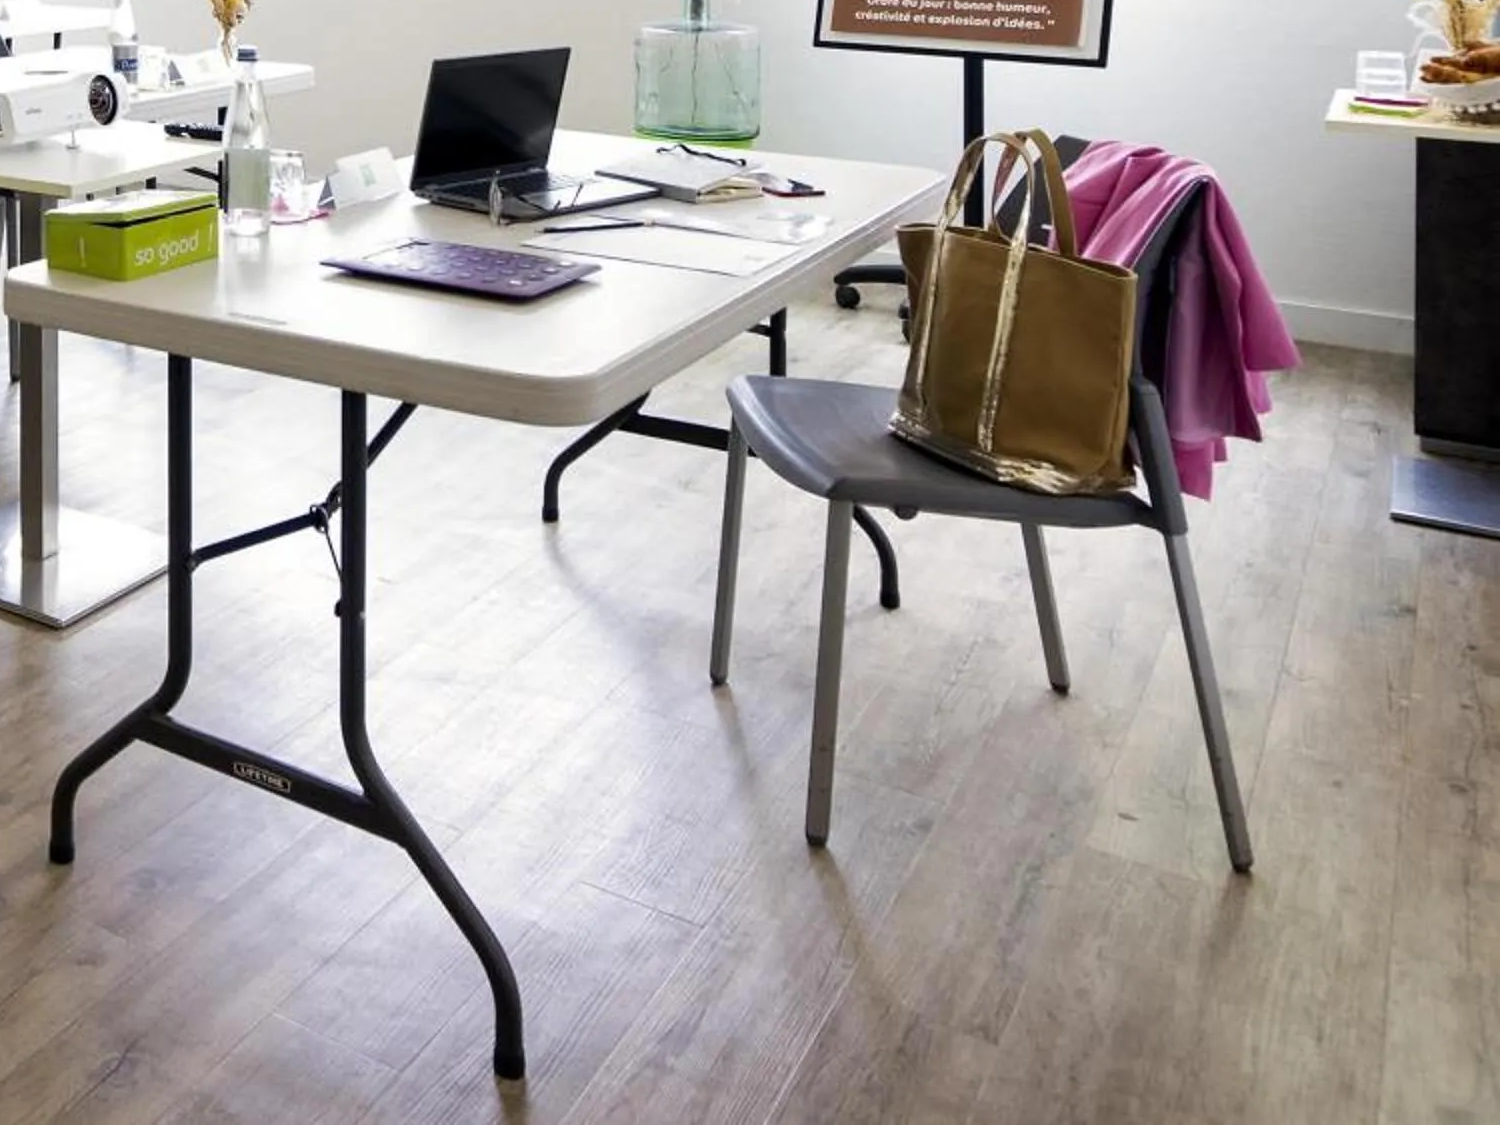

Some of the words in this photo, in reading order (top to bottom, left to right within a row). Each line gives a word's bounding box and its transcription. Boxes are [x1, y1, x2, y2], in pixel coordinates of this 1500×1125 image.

[953, 0, 995, 11] bonne
[854, 10, 911, 23] créativité
[913, 14, 926, 24] et
[927, 15, 991, 27] explosion
[134, 248, 155, 266] so
[159, 229, 200, 265] good
